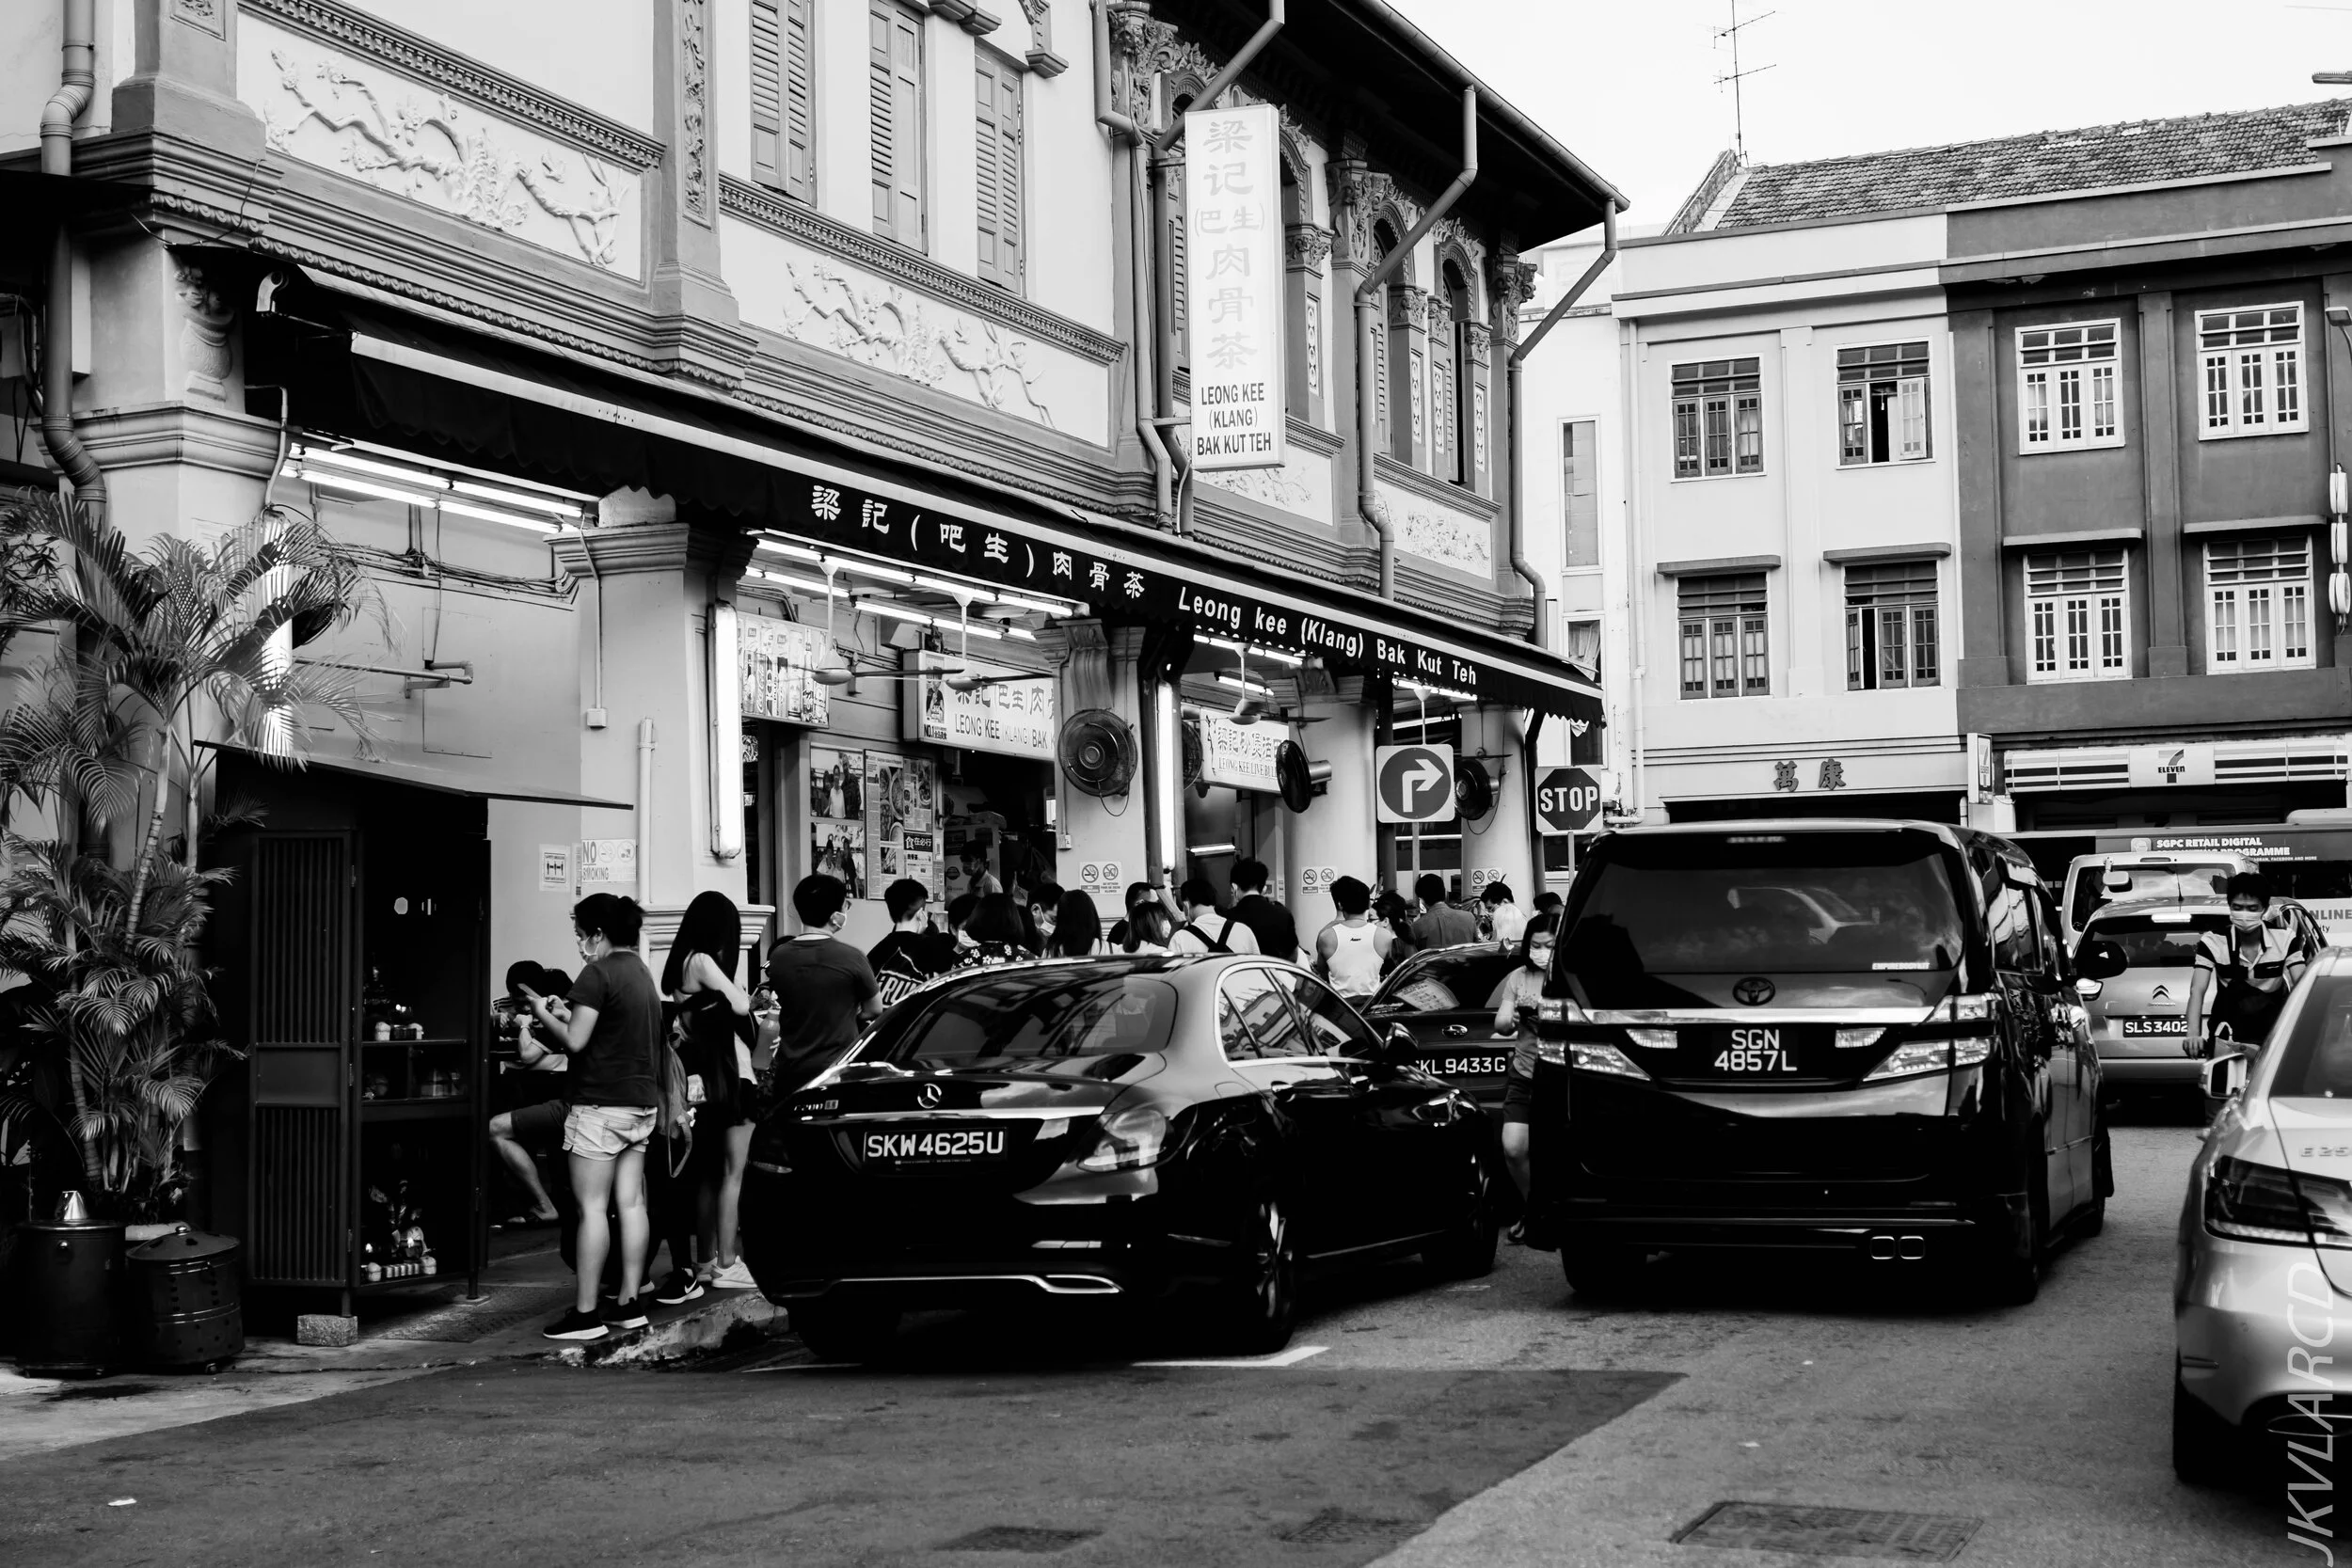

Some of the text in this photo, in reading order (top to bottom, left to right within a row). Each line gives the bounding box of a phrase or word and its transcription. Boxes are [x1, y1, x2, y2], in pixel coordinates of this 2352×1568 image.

[1201, 382, 1264, 405] LEONG KEE
[1209, 406, 1258, 430] (KLANG)
[1197, 432, 1271, 456] BAK KUT TEH
[1179, 586, 1476, 685] Leong kee (Klang) Bak Kut Teh
[955, 714, 982, 736] LEONG
[984, 718, 1001, 739] KEE
[1032, 729, 1048, 749] BAK
[1238, 760, 1250, 774] KEE
[1540, 785, 1598, 813] STOP
[583, 841, 597, 863] NO
[2156, 837, 2262, 848] SGPC RETAIL DIGITAL
[582, 866, 610, 881] SMOKING
[2310, 909, 2352, 920] NLINE
[1731, 1029, 1780, 1050] SGN
[1416, 1057, 1505, 1075] KL9433G
[1714, 1050, 1797, 1071] 4857L
[867, 1132, 1004, 1157] SKW4625U
